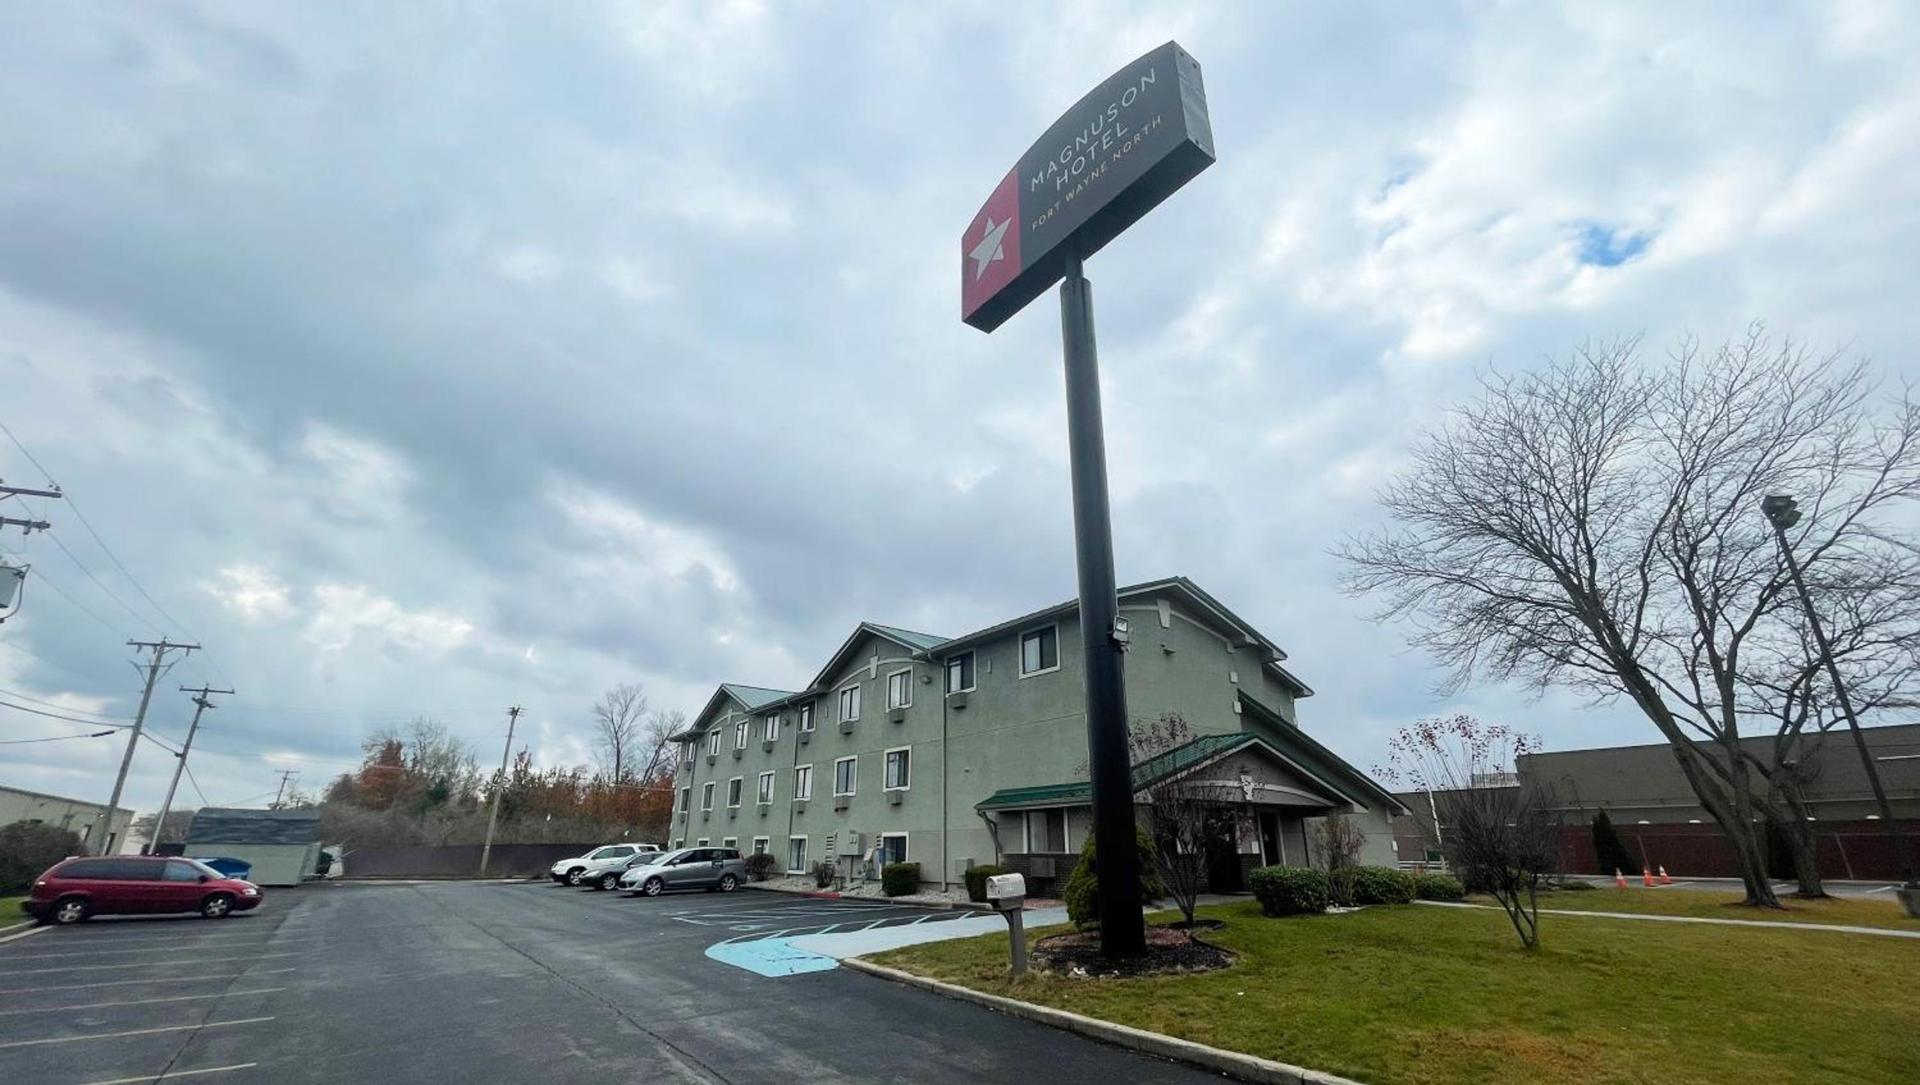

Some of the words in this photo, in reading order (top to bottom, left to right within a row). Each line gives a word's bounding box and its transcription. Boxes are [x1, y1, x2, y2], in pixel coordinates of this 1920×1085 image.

[1031, 68, 1156, 192] MAGNUSON
[1032, 202, 1060, 232] FORT
[1065, 162, 1107, 201] WAYNE
[1113, 115, 1161, 161] NORTH
[1056, 122, 1128, 191] HOTEL
